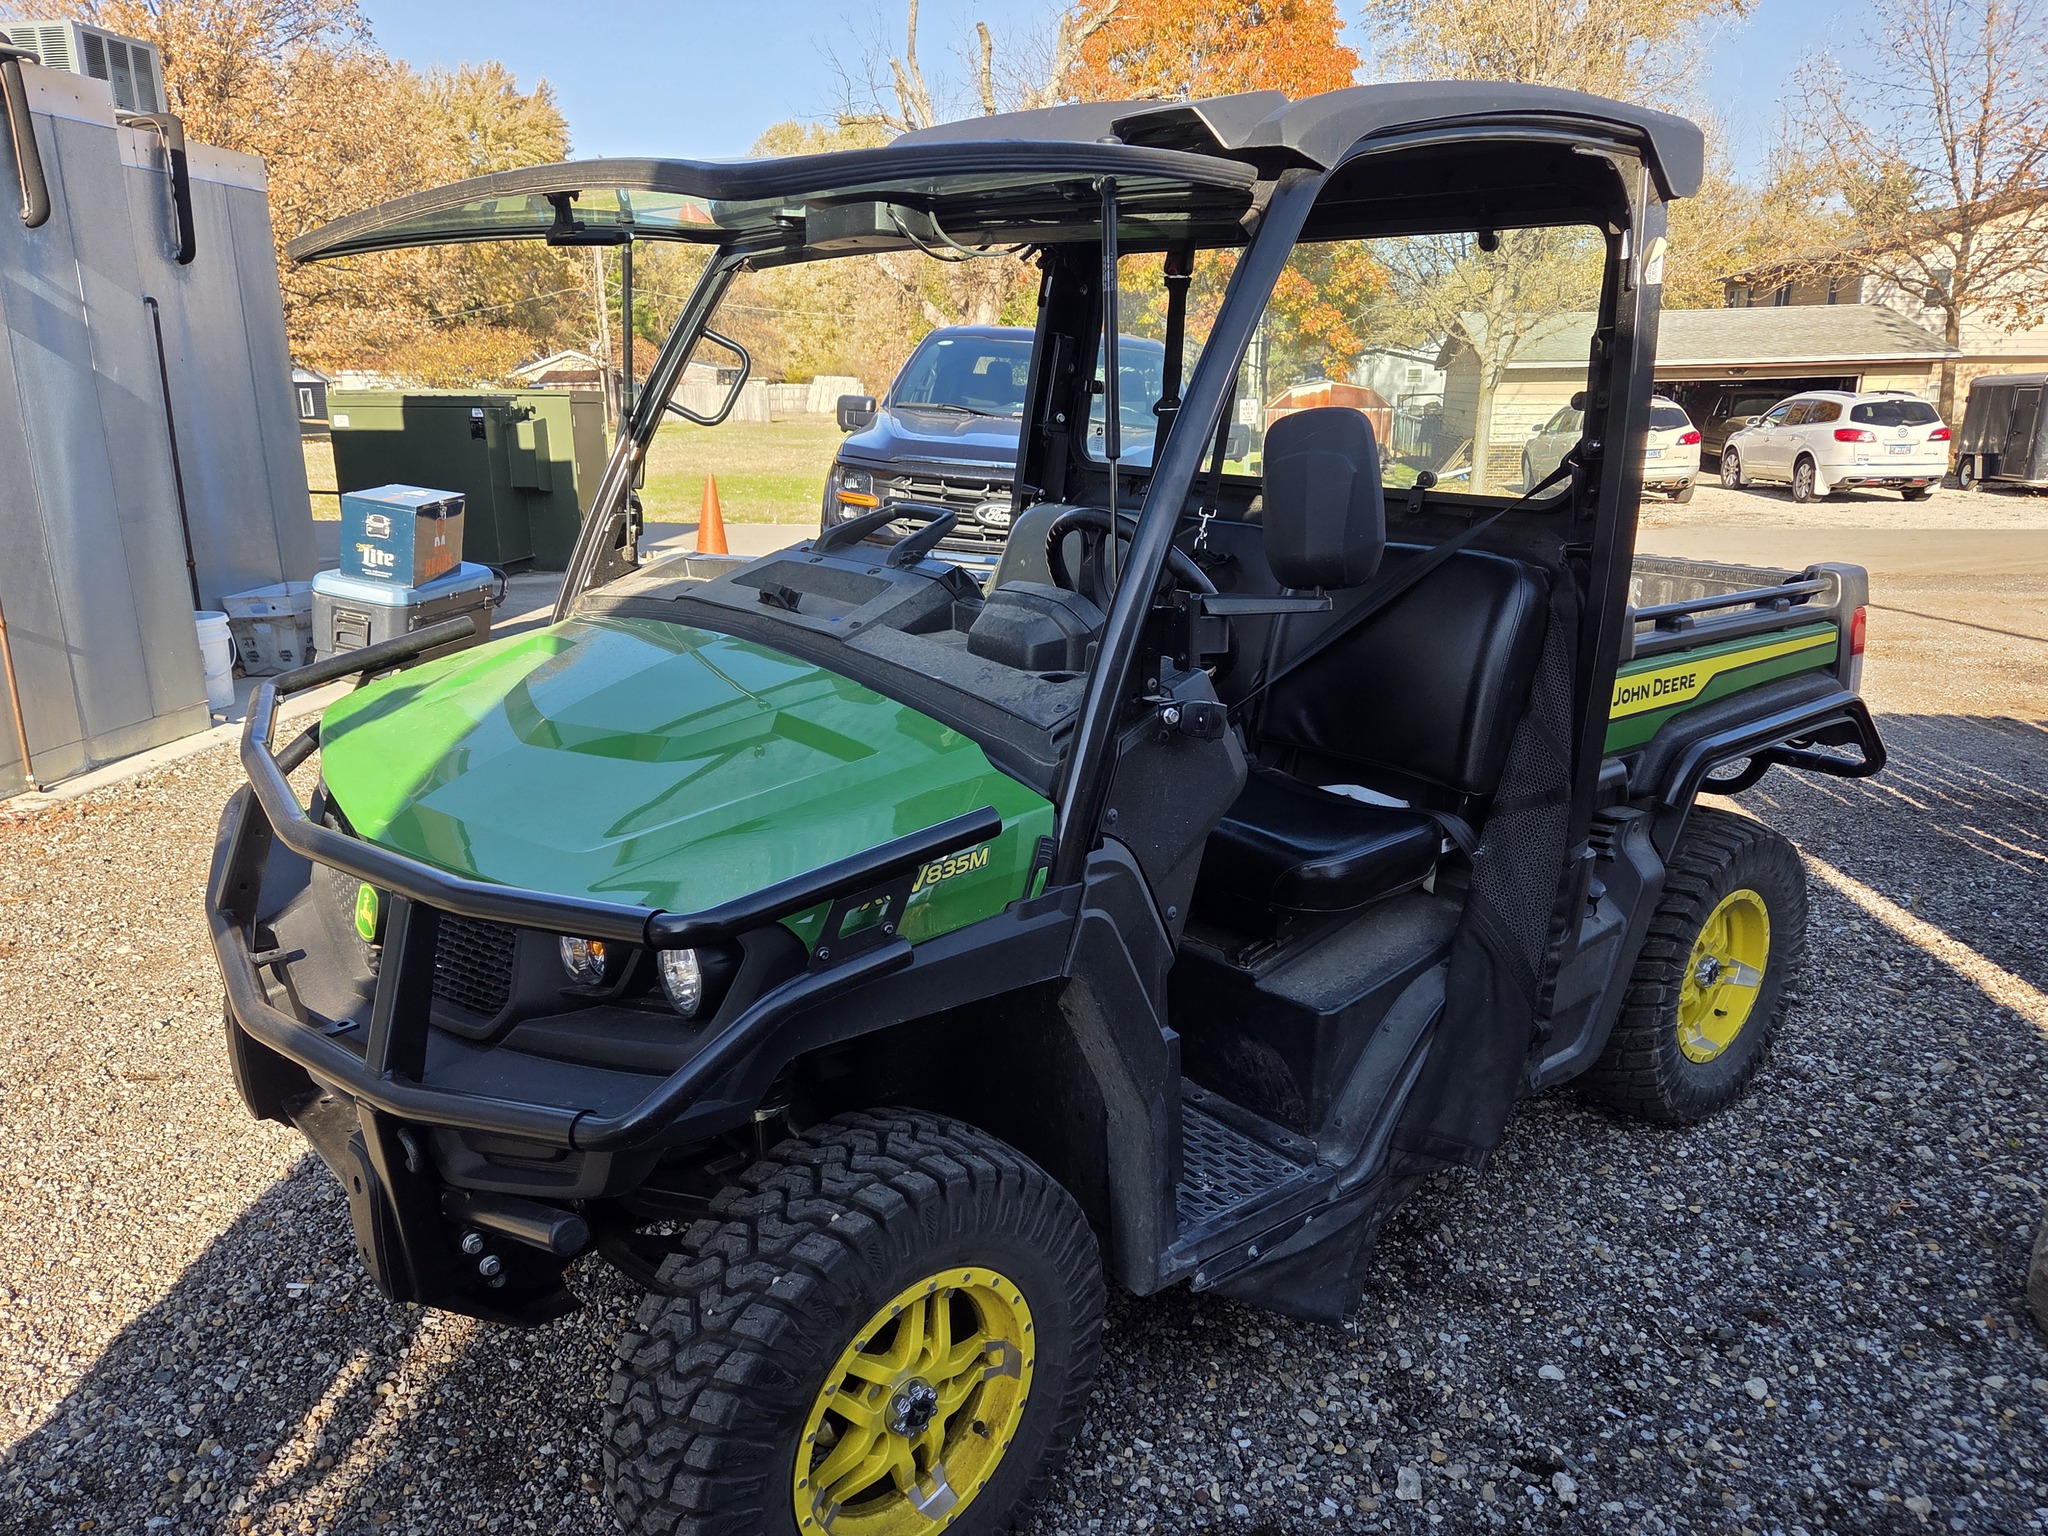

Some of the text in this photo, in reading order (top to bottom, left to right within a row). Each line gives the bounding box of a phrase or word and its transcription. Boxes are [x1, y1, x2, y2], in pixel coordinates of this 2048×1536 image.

[985, 507, 1011, 521] For
[361, 546, 395, 567] Lite
[425, 553, 454, 576] BEARS
[1612, 673, 1697, 707] JOHN DEERE
